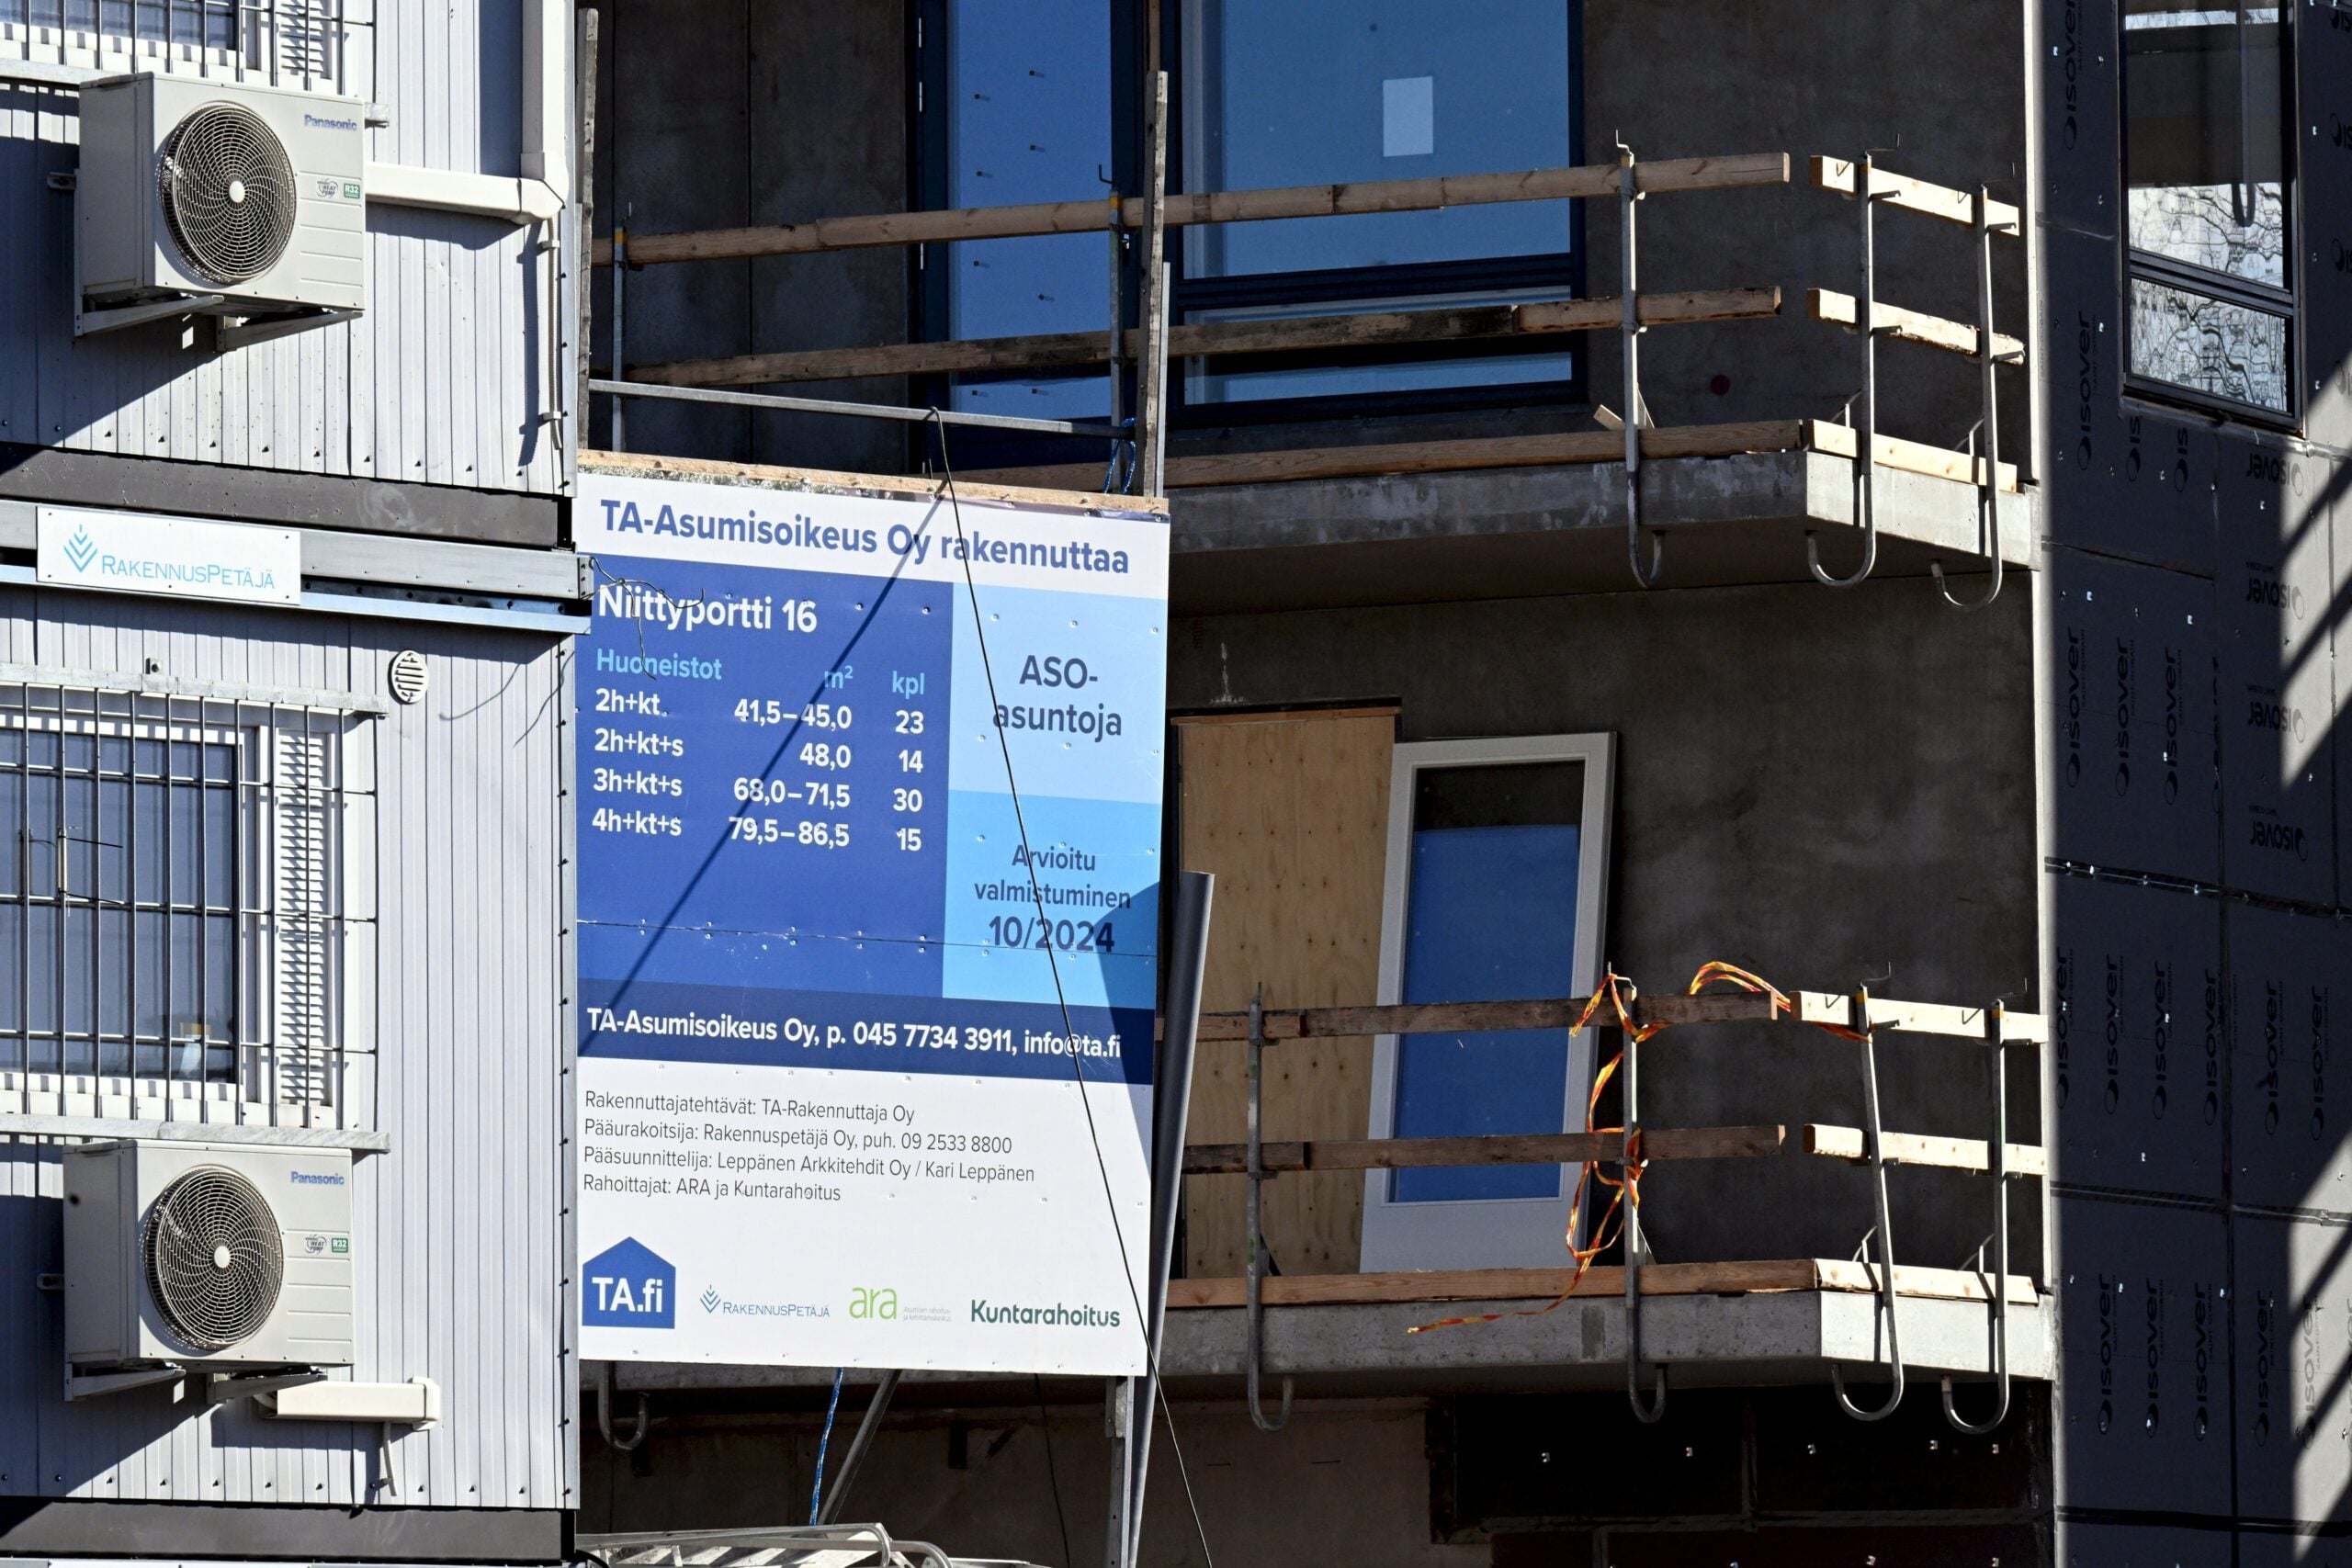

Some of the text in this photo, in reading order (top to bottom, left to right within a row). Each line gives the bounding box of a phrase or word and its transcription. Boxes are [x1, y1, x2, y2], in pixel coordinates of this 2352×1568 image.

[304, 114, 357, 130] Panasonic
[345, 184, 359, 193] R32
[600, 499, 1129, 574] TA-Asumisoikeus Oy rakennuttaa
[598, 584, 818, 632] Niittyportti 16
[596, 648, 723, 681] Huoneistot
[892, 671, 925, 699] kpl
[1019, 654, 1099, 690] ASO-
[595, 688, 661, 716] 2h+kt
[895, 710, 923, 734] 23
[992, 703, 1123, 743] asuntoja
[594, 728, 923, 773] 2h+kt+s 48,0 14
[593, 768, 683, 796] 3h+kt+s
[893, 788, 923, 812] 30
[592, 807, 682, 836] 4h+kt+s
[897, 828, 922, 852] 15
[1012, 844, 1096, 872] Arvioitu
[975, 879, 1131, 909] valmistuminen
[989, 916, 1115, 953] 10/2024
[587, 1008, 1122, 1057] TA-Asumisoikeus Oy, p. 045 7734 3911, info@ta.fi
[585, 1090, 915, 1125] Rakennuttajatehtävät: TA-Rakennuttaja Oy
[585, 1119, 1012, 1154] Pääurakoitsija: Rakennuspetäjä Oy, puh. 09 2533 8800
[290, 1171, 345, 1185] Panasonic
[584, 1146, 1035, 1183] Pääsuunnittelija: Leppänen Arkkitehdit Oy / Kari Leppänen
[583, 1174, 842, 1201] Rahoittajat: ARA ja Kuntarahoitus
[334, 1239, 346, 1247] R32
[592, 1277, 663, 1313] TA.fi
[849, 1287, 897, 1320] ara
[971, 1299, 1121, 1327] Kuntarahoitus
